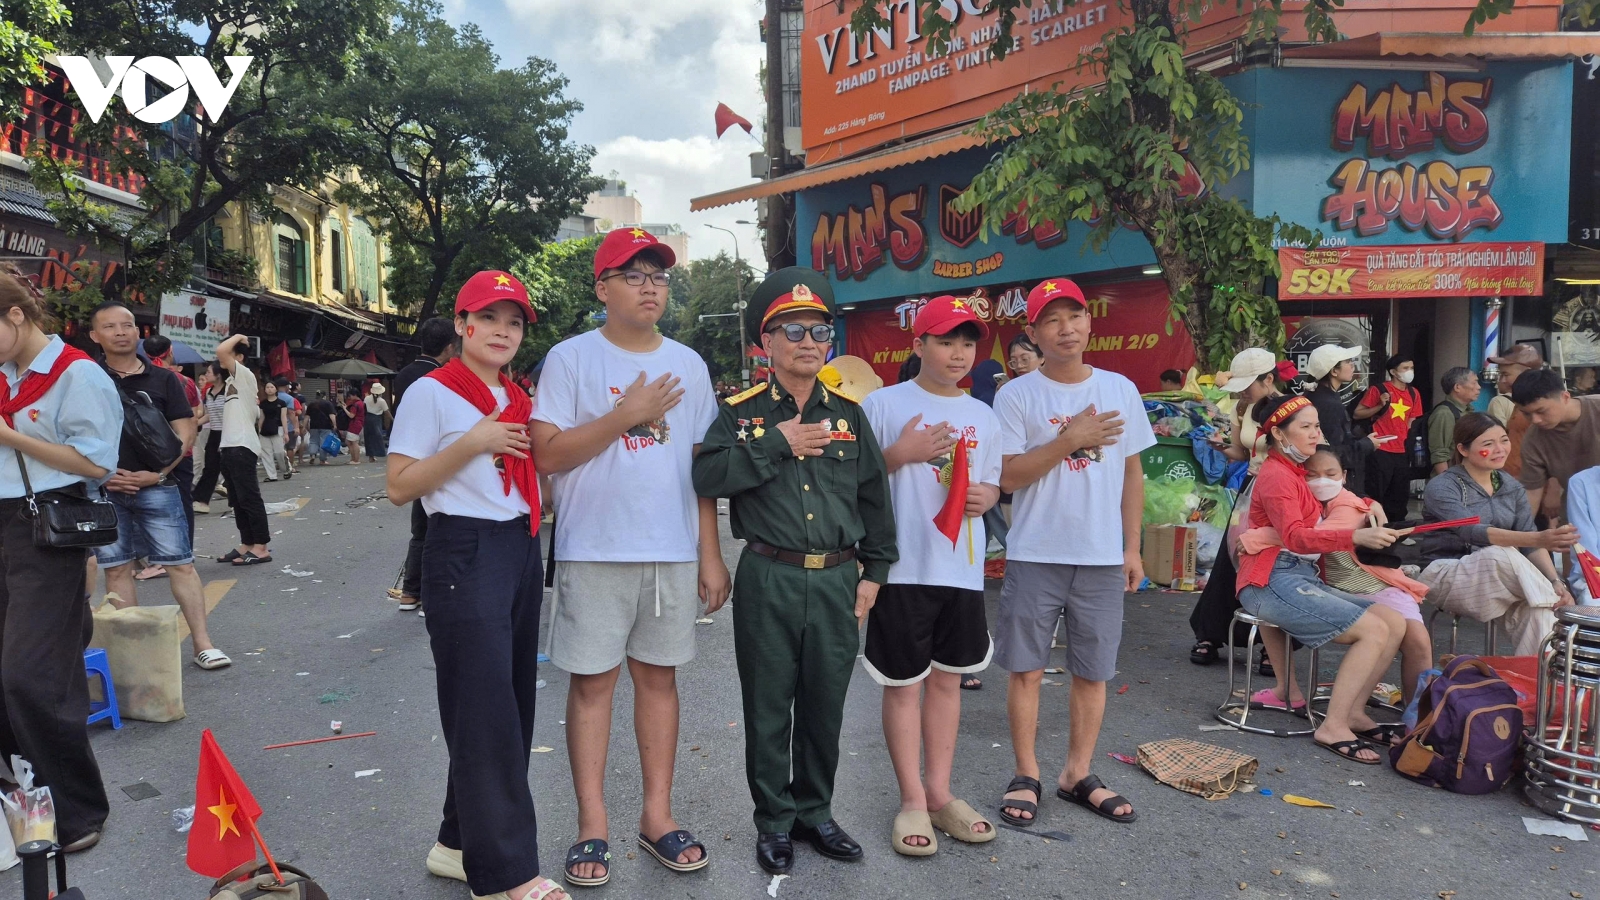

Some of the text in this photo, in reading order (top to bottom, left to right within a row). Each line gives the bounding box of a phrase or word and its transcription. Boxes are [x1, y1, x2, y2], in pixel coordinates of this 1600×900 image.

[889, 62, 949, 94] FANPAGE:
[1030, 5, 1107, 46] SCARLET
[836, 68, 877, 95] 2HAND
[880, 45, 922, 78] TUYỂN
[838, 122, 849, 131] 225
[850, 116, 866, 126] Hàng
[1321, 157, 1503, 239] HOUSE
[8, 229, 46, 256] HÀNG
[1581, 228, 1590, 239] 3
[933, 251, 1003, 278] BARBER SHOP
[1366, 246, 1536, 273] QUÀ TẶNG CẮT TÓC TRẢI NGHIỆM LẦN ĐẦU
[1287, 268, 1358, 294] 59K
[1368, 279, 1384, 291] Cam
[1434, 274, 1461, 290] 300%
[873, 346, 890, 363] KỶ
[1126, 333, 1159, 350] 2/9
[1276, 408, 1288, 418] TÔI
[1284, 401, 1298, 411] YÊU
[621, 433, 655, 453] TỰ DO
[1065, 457, 1080, 473] TỰ
